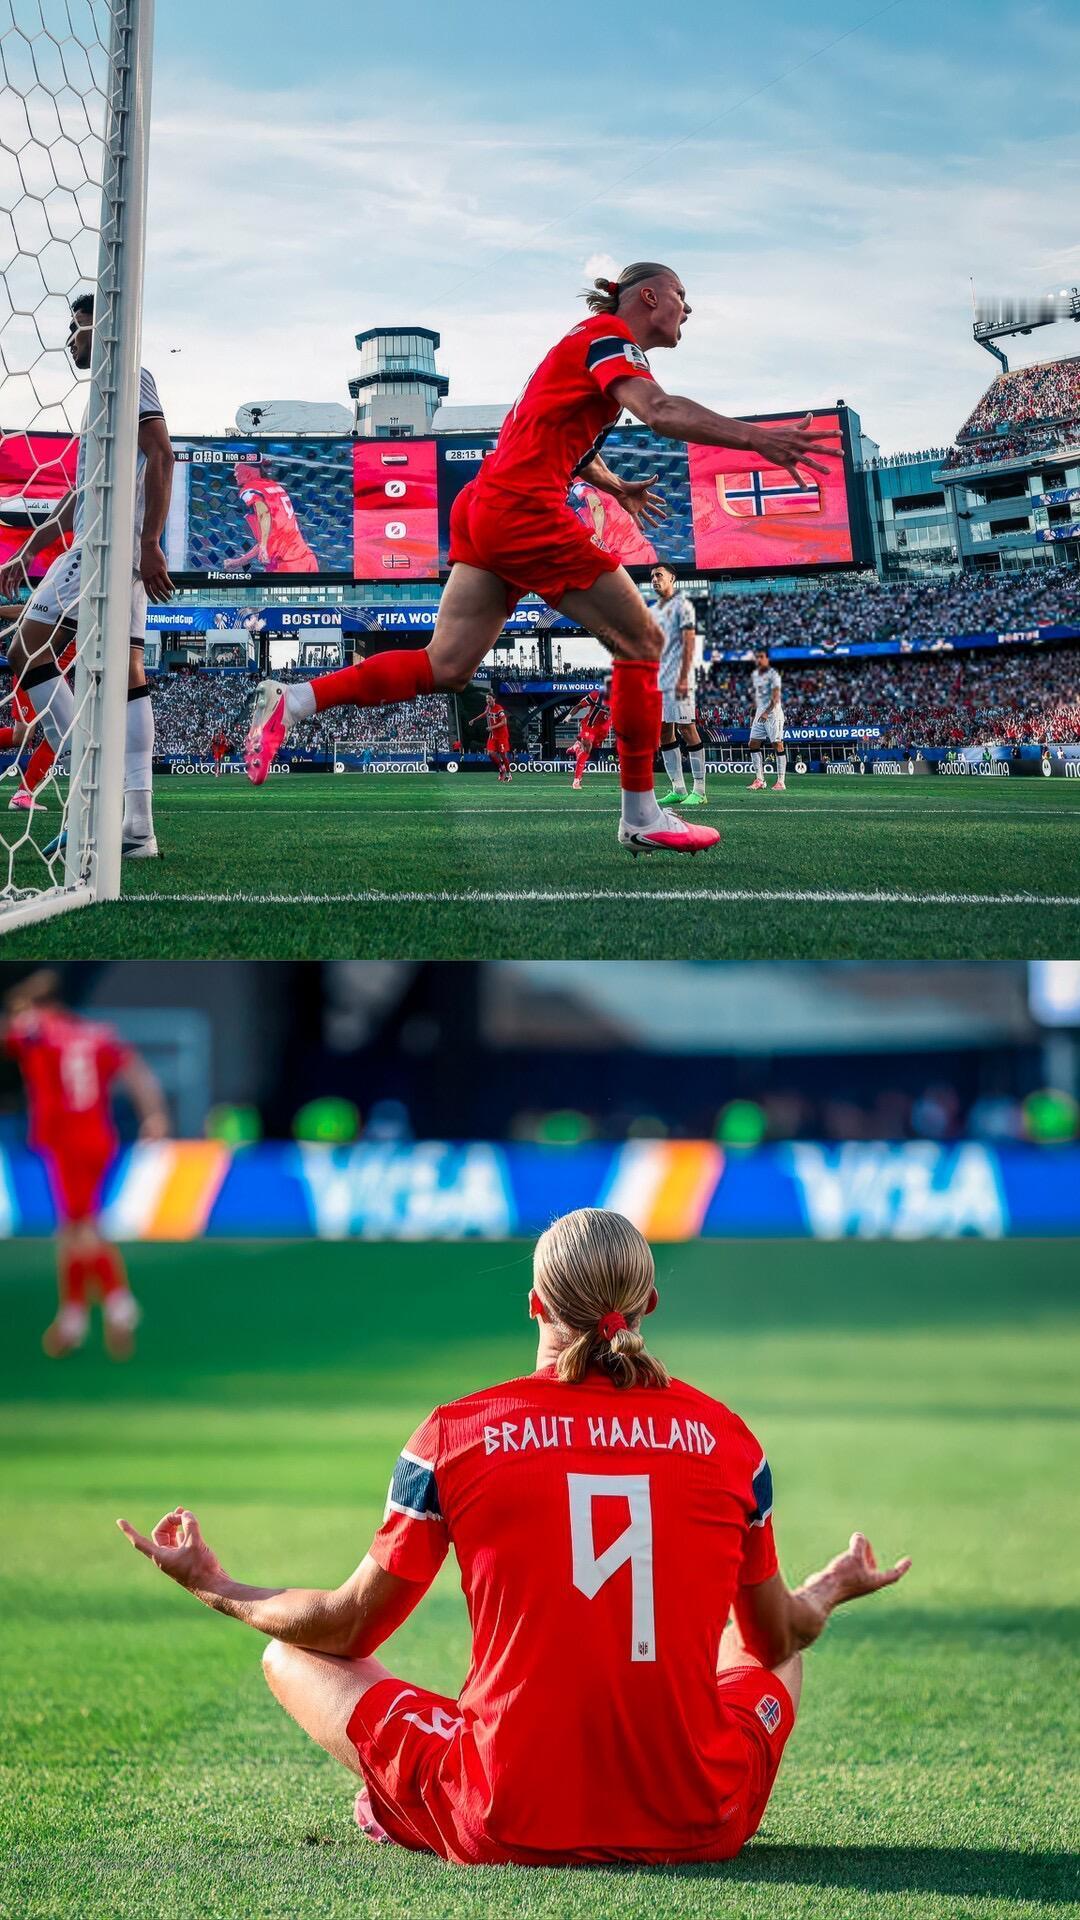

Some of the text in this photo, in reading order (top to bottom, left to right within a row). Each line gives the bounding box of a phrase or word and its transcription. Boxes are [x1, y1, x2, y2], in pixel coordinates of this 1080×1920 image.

[451, 451, 476, 460] 28:15
[207, 571, 252, 580] Hisense
[32, 603, 49, 613] JAKO
[282, 613, 342, 625] BOSTON
[377, 613, 407, 624] FIFA
[552, 683, 568, 691] FIFA
[568, 683, 594, 691] WORLD
[792, 730, 828, 739] WORLD
[829, 729, 849, 738] CUP
[850, 728, 880, 737] 2026
[509, 761, 560, 772] ootball
[564, 763, 574, 772] is
[979, 760, 1009, 776] calling
[483, 1416, 717, 1456] BRAUT HAALAND
[566, 1472, 657, 1662] 9
